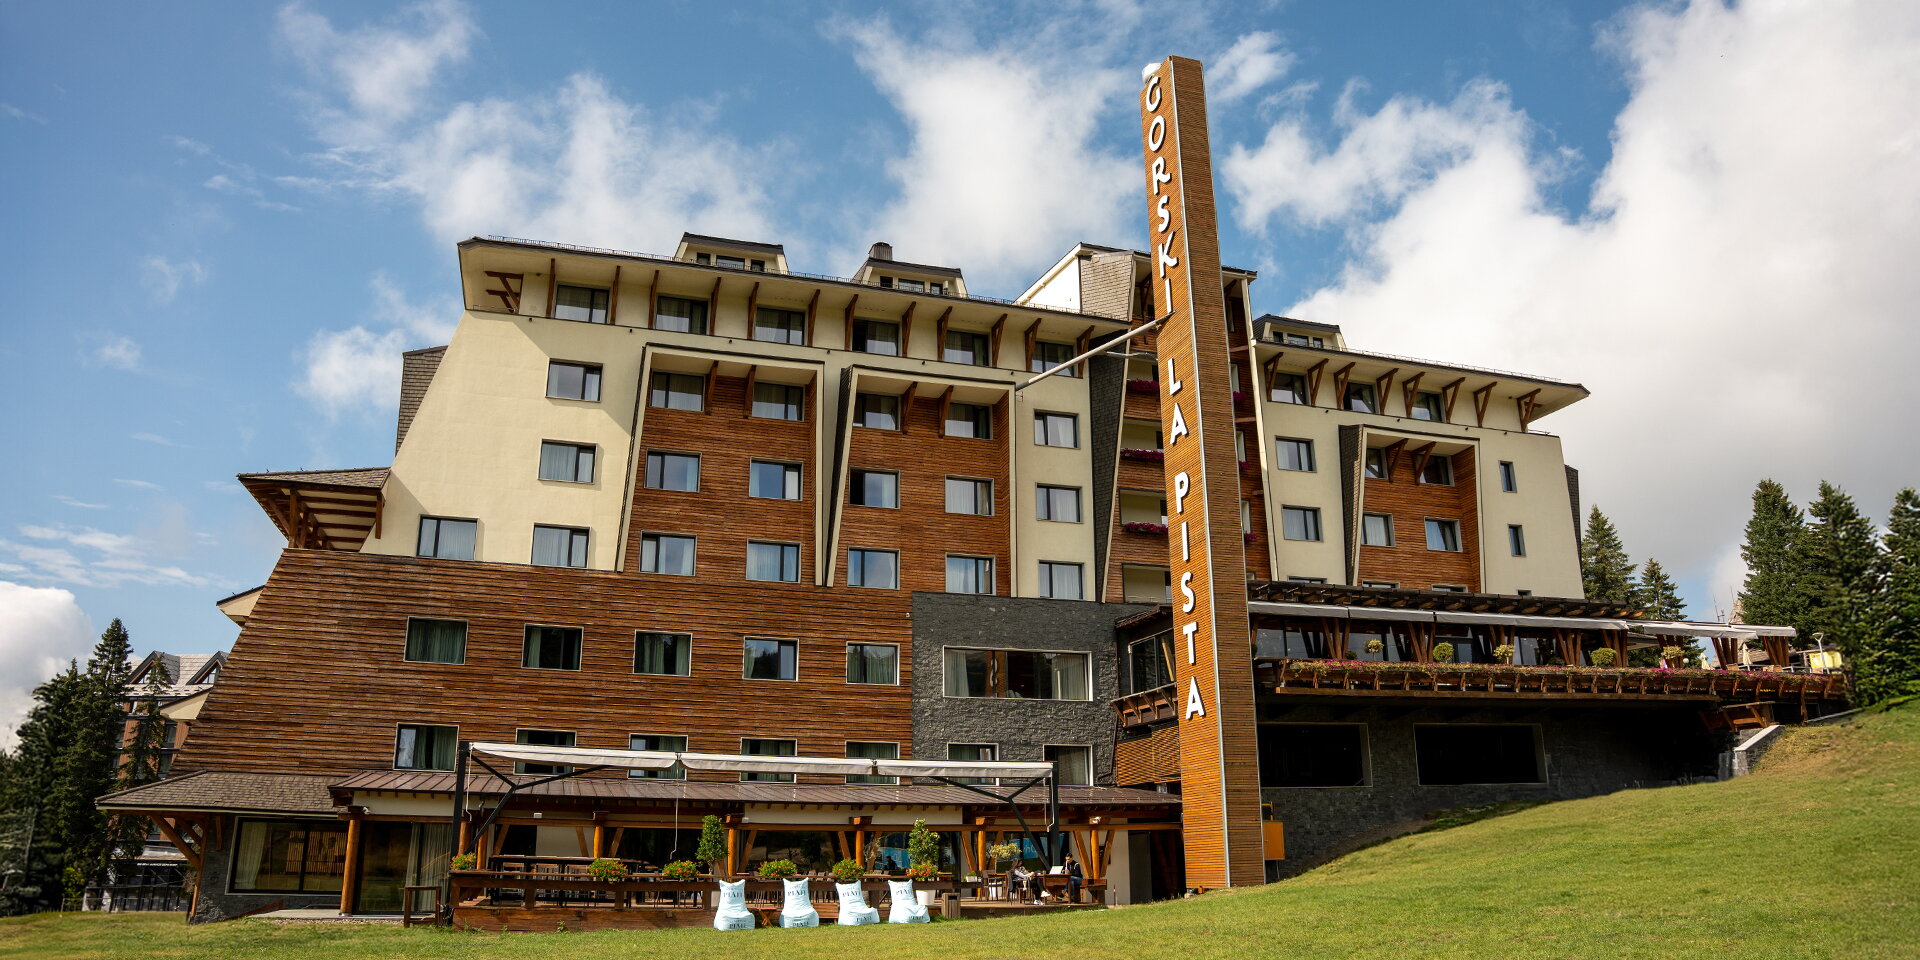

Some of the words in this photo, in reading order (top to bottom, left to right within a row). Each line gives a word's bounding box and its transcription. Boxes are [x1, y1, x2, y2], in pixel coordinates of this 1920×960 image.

[1145, 76, 1178, 314] GORSKI
[1168, 358, 1188, 445] LA
[1175, 471, 1206, 719] PISTA
